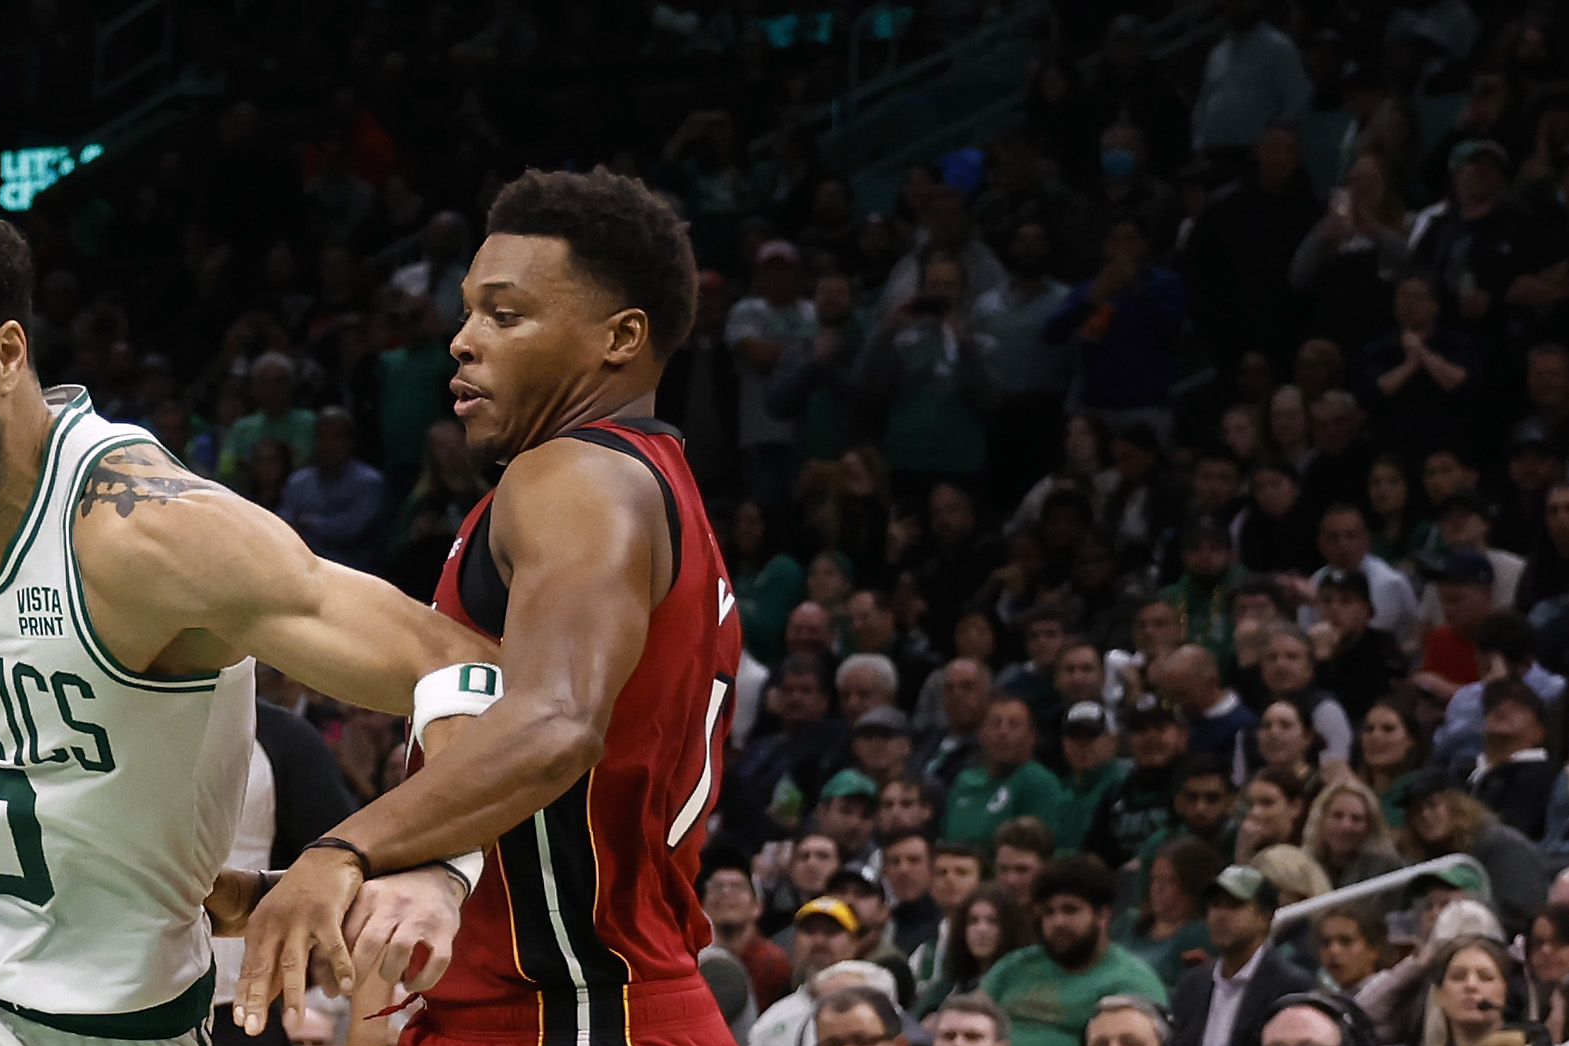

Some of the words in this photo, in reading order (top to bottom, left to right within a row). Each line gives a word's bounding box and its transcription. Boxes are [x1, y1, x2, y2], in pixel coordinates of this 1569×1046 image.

[17, 587, 63, 615] VISTA
[19, 617, 63, 636] PRINT
[459, 664, 497, 696] 0
